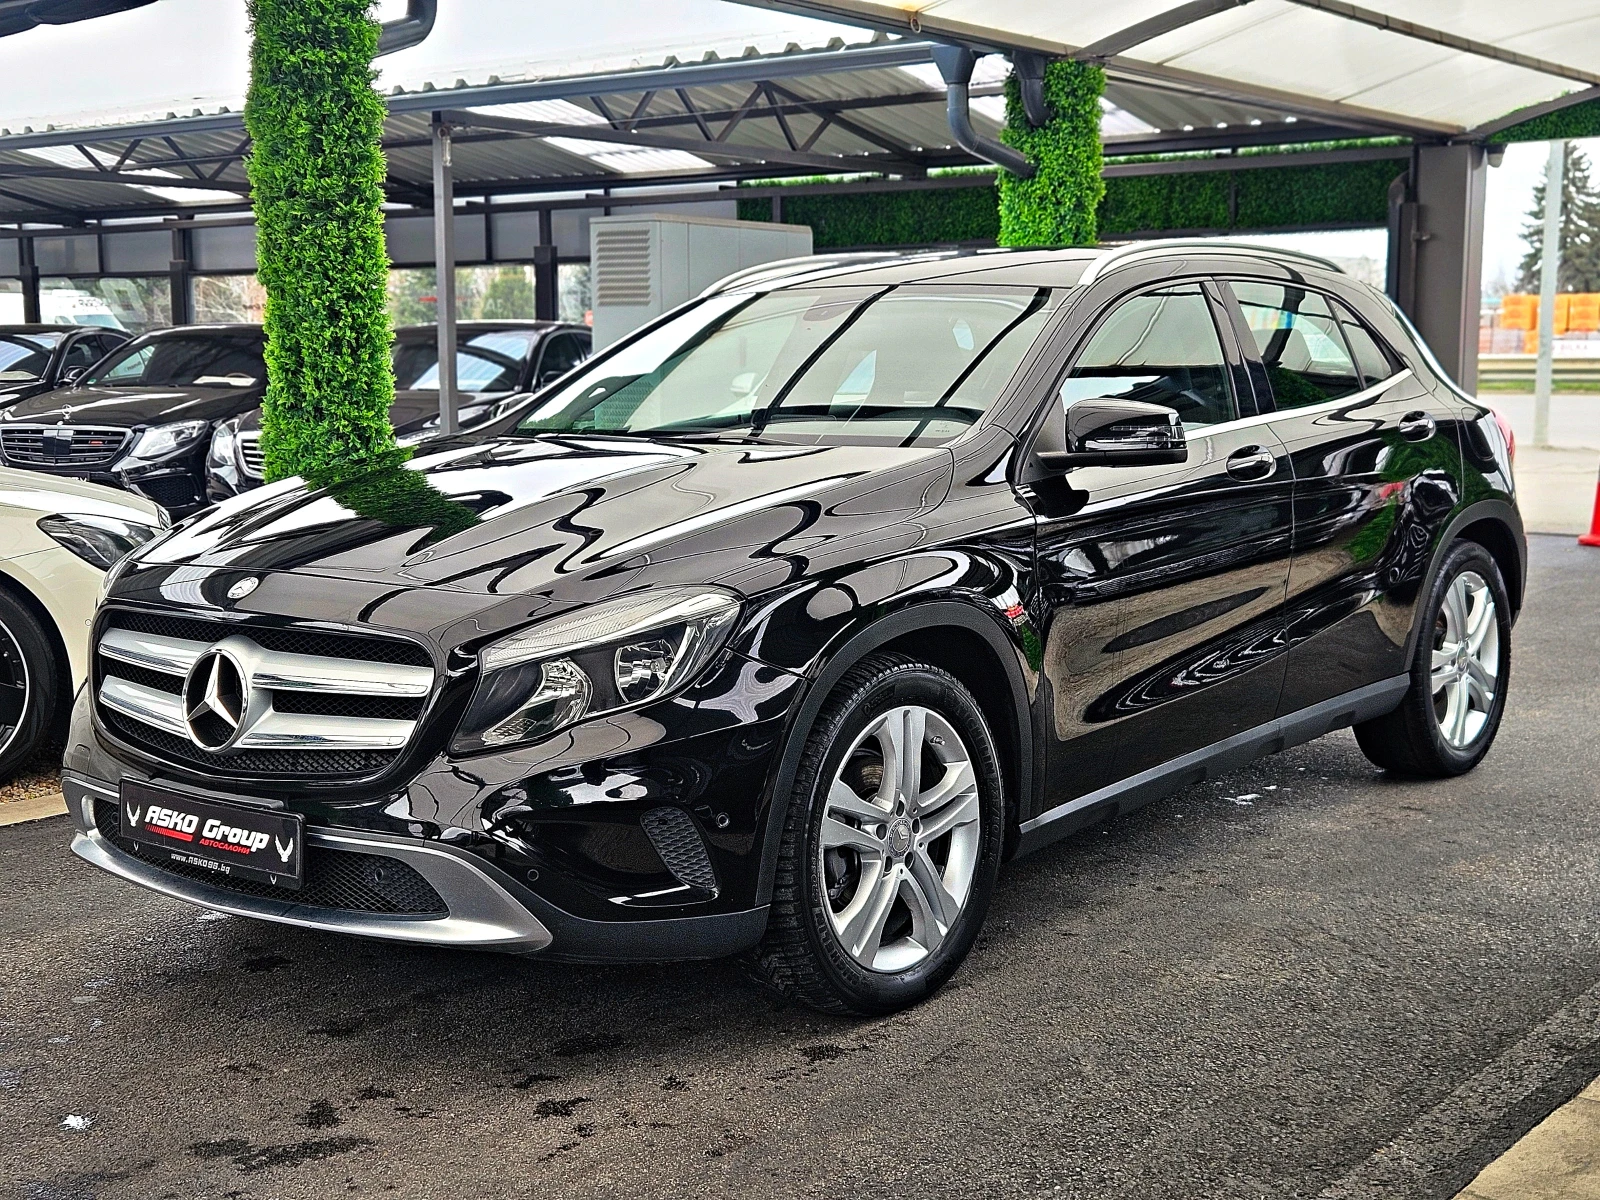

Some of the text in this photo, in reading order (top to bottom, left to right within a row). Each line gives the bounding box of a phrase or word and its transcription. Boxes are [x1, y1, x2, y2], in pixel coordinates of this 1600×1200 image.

[144, 805, 270, 852] ASKO Group
[199, 838, 251, 855] АВТОСАЛОНИ
